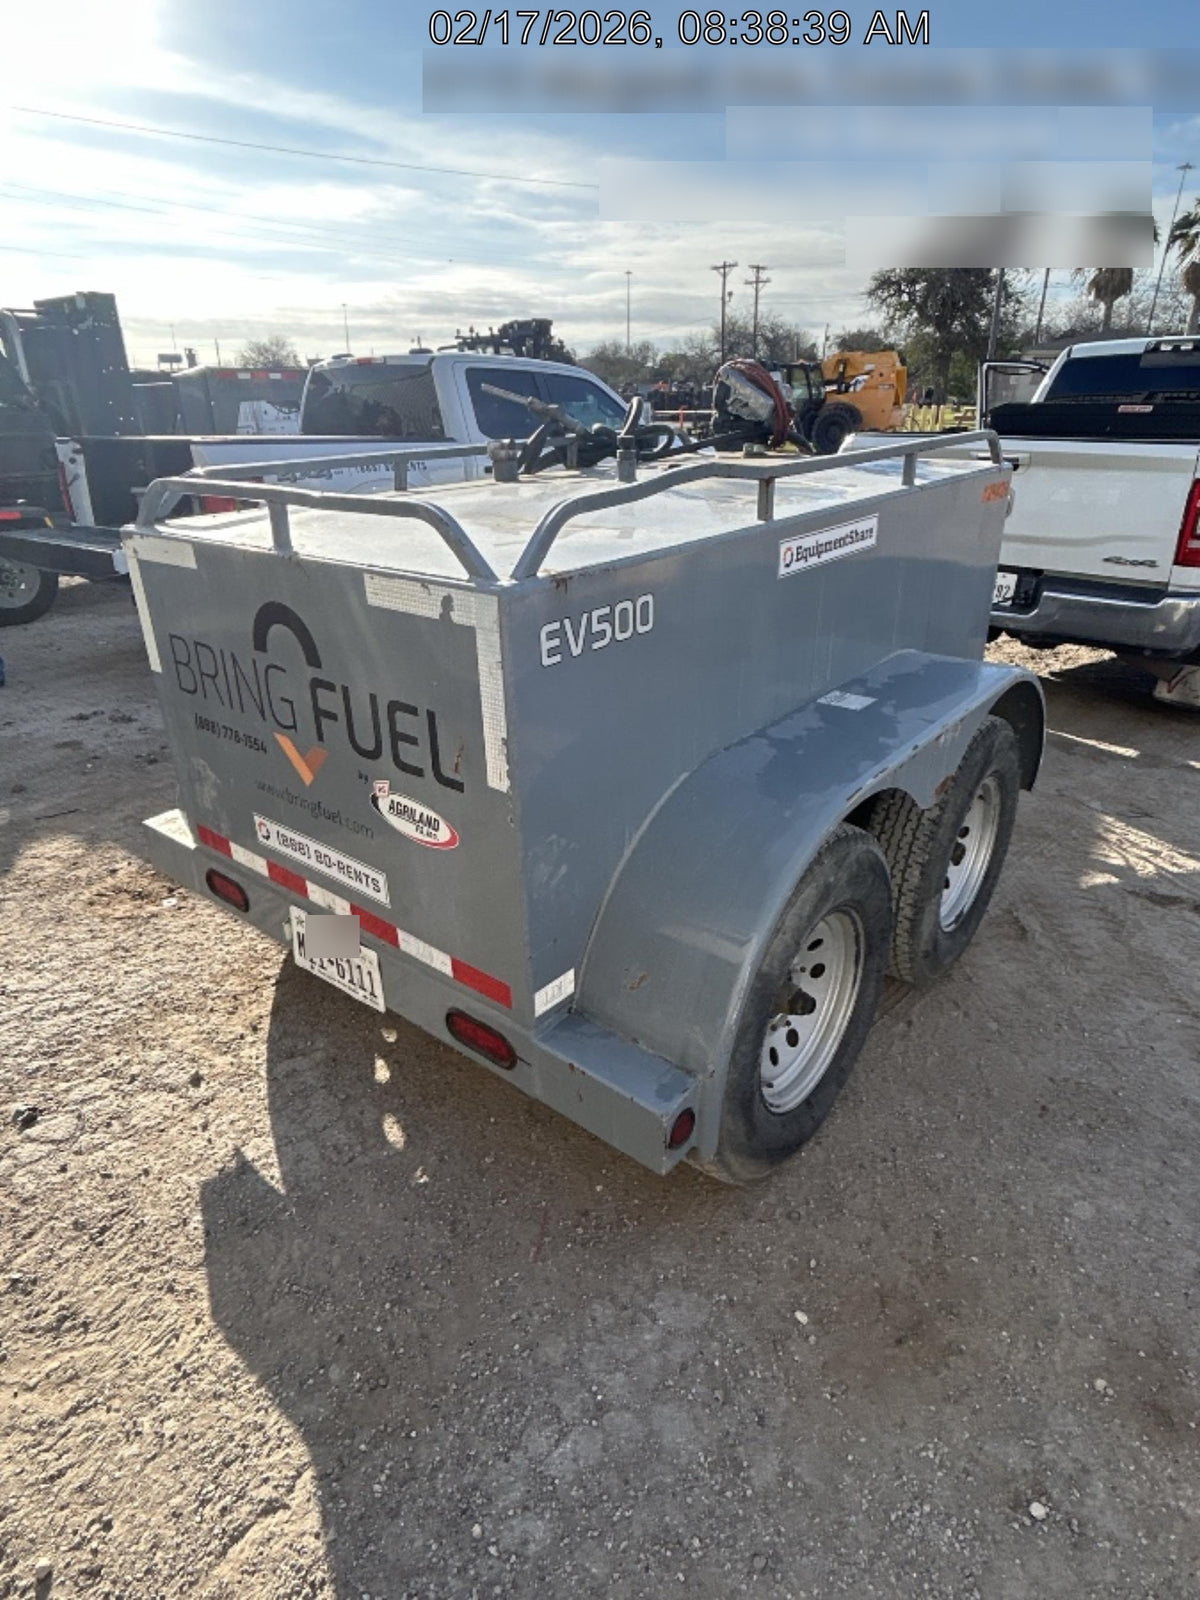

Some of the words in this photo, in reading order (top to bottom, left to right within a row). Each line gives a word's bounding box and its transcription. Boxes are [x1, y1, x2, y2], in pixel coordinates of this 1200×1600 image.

[795, 527, 873, 563] EquipmentShare
[540, 592, 654, 667] EV500
[169, 632, 298, 734] BRING
[309, 677, 464, 793] FUEL
[389, 799, 440, 833] AGRILAND
[276, 829, 311, 860] (888)
